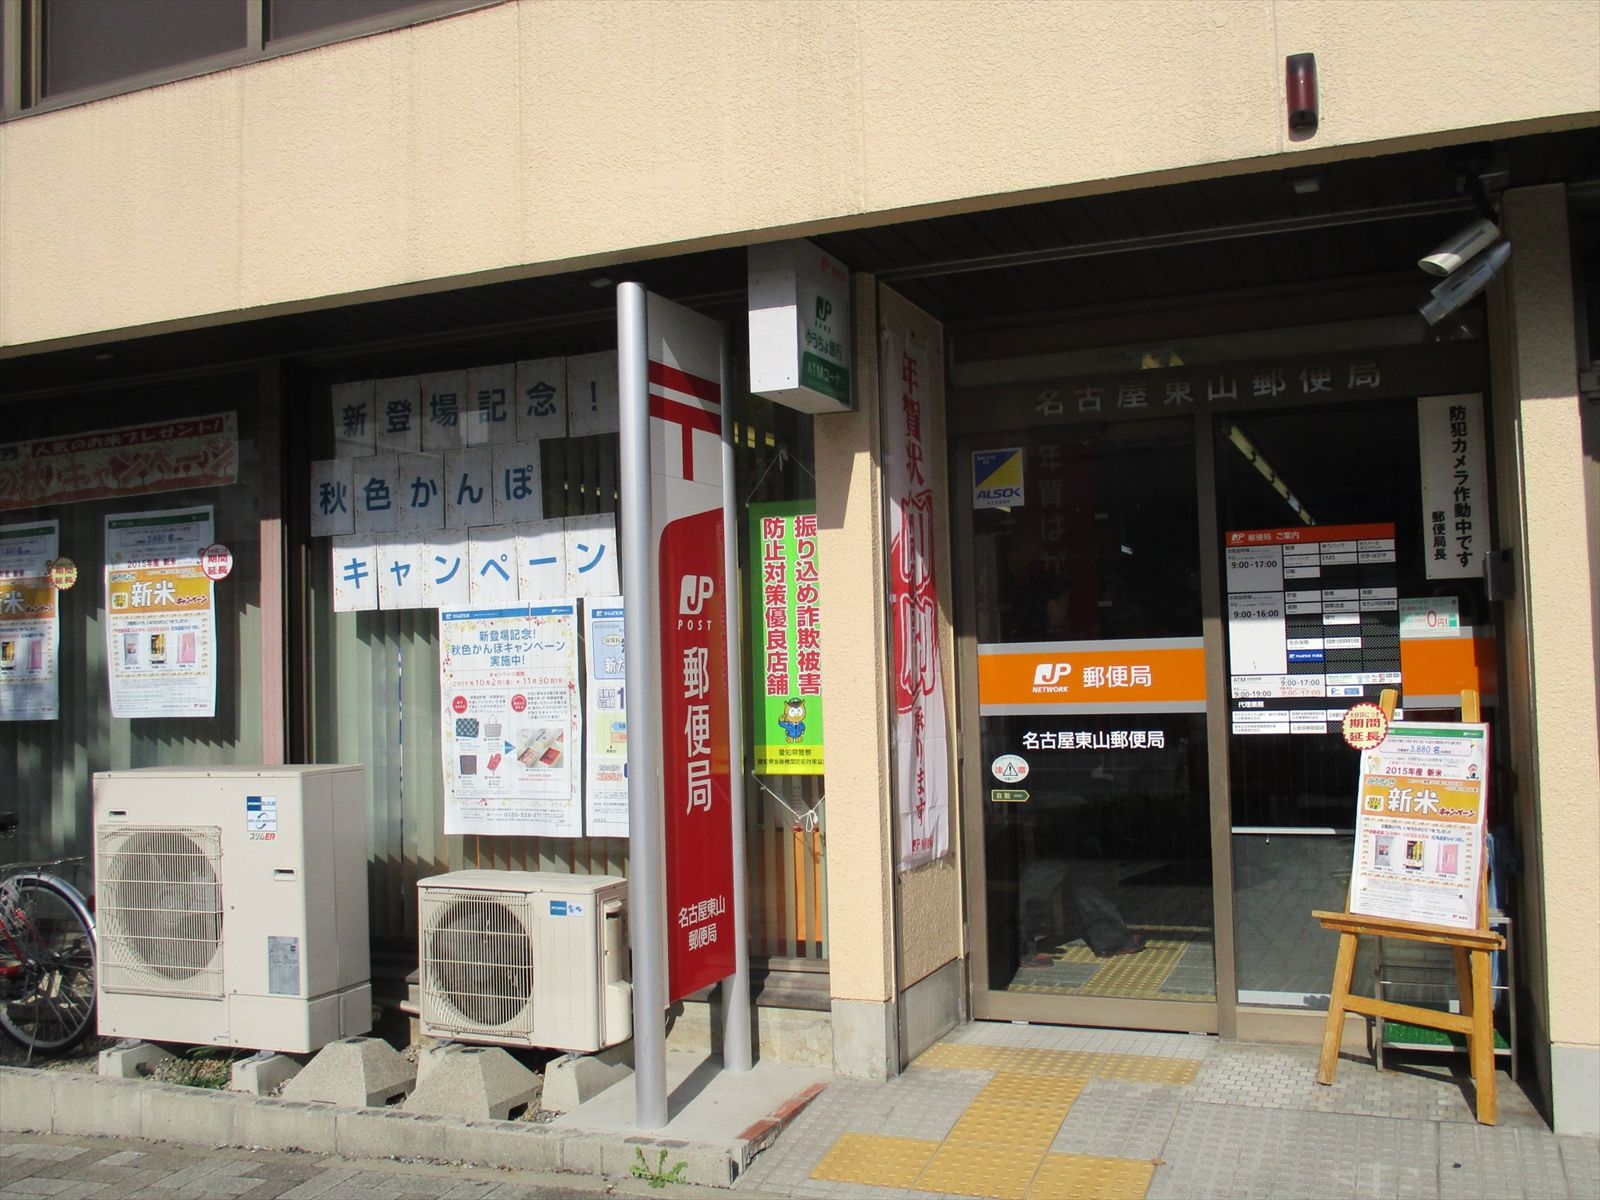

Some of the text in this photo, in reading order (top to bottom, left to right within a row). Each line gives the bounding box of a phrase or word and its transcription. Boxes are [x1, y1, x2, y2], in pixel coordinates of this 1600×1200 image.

[806, 328, 842, 361] ゆうちょ銀行
[1035, 360, 1382, 416] 名古屋東山郵便局
[319, 463, 535, 515] 秋色かんぽ
[976, 488, 1021, 499] ALSOK
[1449, 405, 1473, 568] 防犯カメラ作動中です
[1432, 510, 1447, 561] 郵便局長
[342, 543, 606, 589] キャンペーン
[0, 590, 25, 615] 米
[131, 580, 177, 607] 新米
[763, 517, 790, 696] 防止対策優良店舗
[793, 513, 822, 695] 振り込め詐欺被害
[479, 628, 536, 641] 新登場記念!
[678, 619, 713, 631] POST
[451, 641, 566, 656] 秋色かんぽキャンペーン
[490, 655, 526, 668] 実施中!
[1083, 665, 1152, 688] 郵便局
[683, 646, 713, 816] 郵便局
[1349, 718, 1381, 729] 期間
[1349, 731, 1381, 742] 延長
[1022, 730, 1165, 750] 名古屋東山郵便局
[1385, 766, 1423, 777] 2015年産
[1387, 787, 1440, 815] 新米
[1439, 808, 1476, 818] キャンペーン
[678, 894, 726, 928] 名古屋東山
[688, 923, 717, 952] 郵便局
